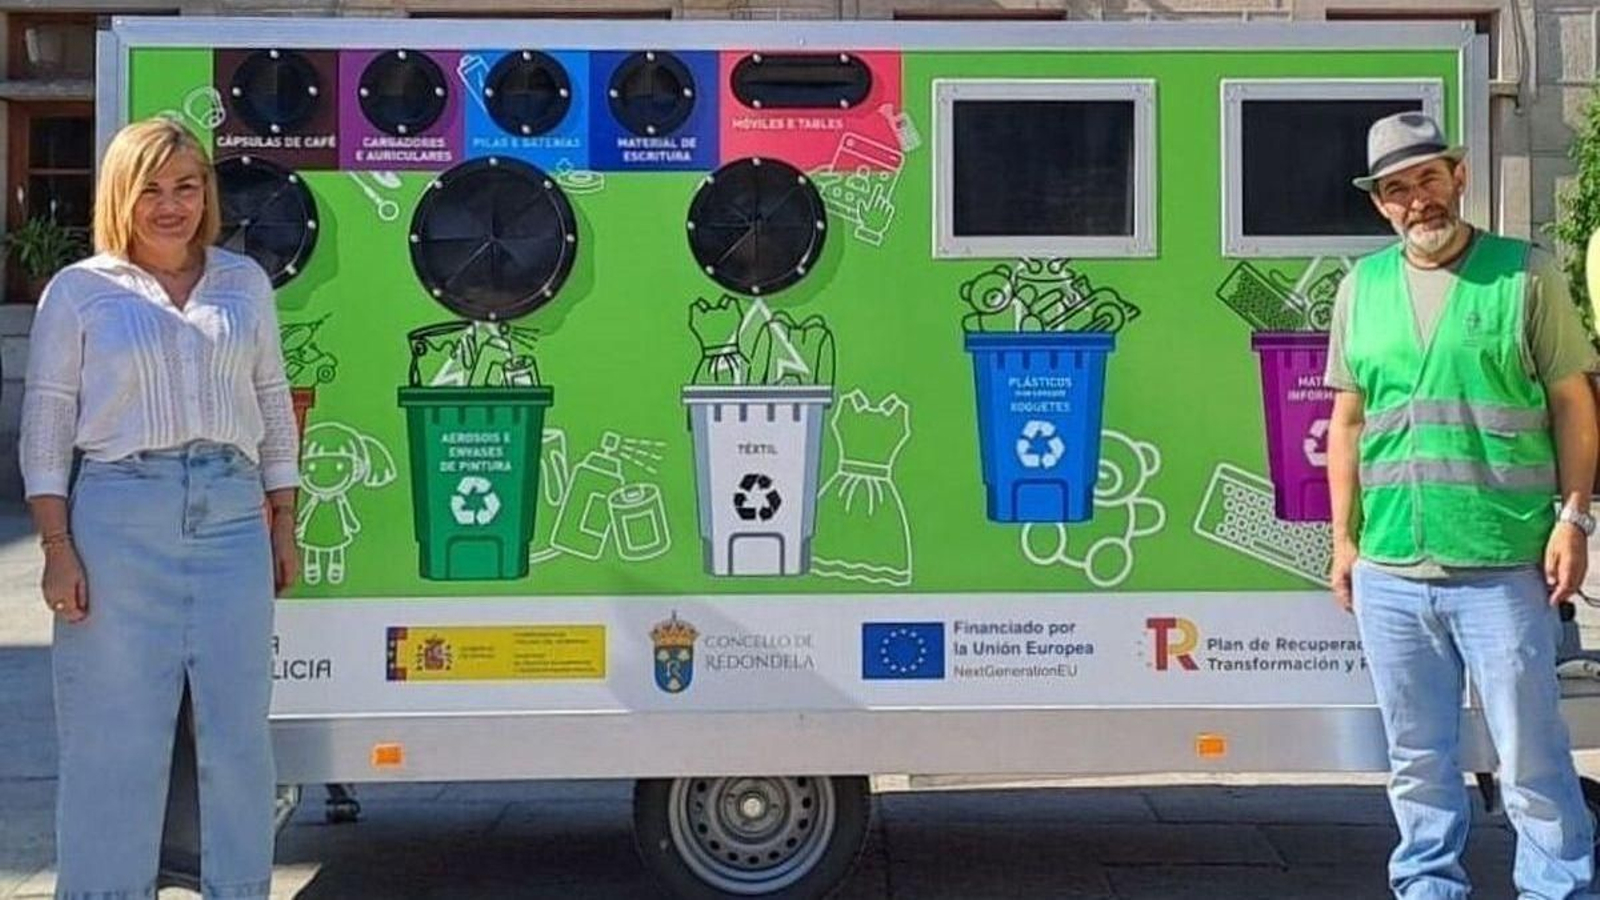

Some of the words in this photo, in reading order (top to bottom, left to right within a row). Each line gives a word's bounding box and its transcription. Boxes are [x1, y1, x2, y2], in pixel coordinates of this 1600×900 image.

[283, 135, 301, 148] DE
[304, 133, 337, 148] CAFÉ
[362, 136, 446, 148] CARGADORES
[617, 137, 678, 149] MATERIAL
[681, 137, 697, 148] DE
[355, 150, 364, 161] E
[365, 150, 453, 161] AURICULARES
[623, 150, 692, 162] ESCRITURA
[1008, 375, 1072, 389] PLÁSTICOS
[448, 446, 503, 458] ENVASES
[440, 461, 456, 472] DE
[458, 460, 512, 472] PINTURA
[953, 620, 1044, 635] Financiado
[1048, 622, 1076, 638] por
[704, 634, 791, 649] CONCELLO
[1207, 637, 1244, 651] Plan
[1249, 637, 1270, 651] de
[953, 641, 968, 656] la
[972, 640, 1022, 656] Unión
[1026, 640, 1094, 659] Europea
[704, 654, 816, 671] REDONDELA
[1206, 655, 1340, 671] Transformación
[1345, 660, 1355, 675] y
[953, 663, 1078, 679] NextGenerationEU
